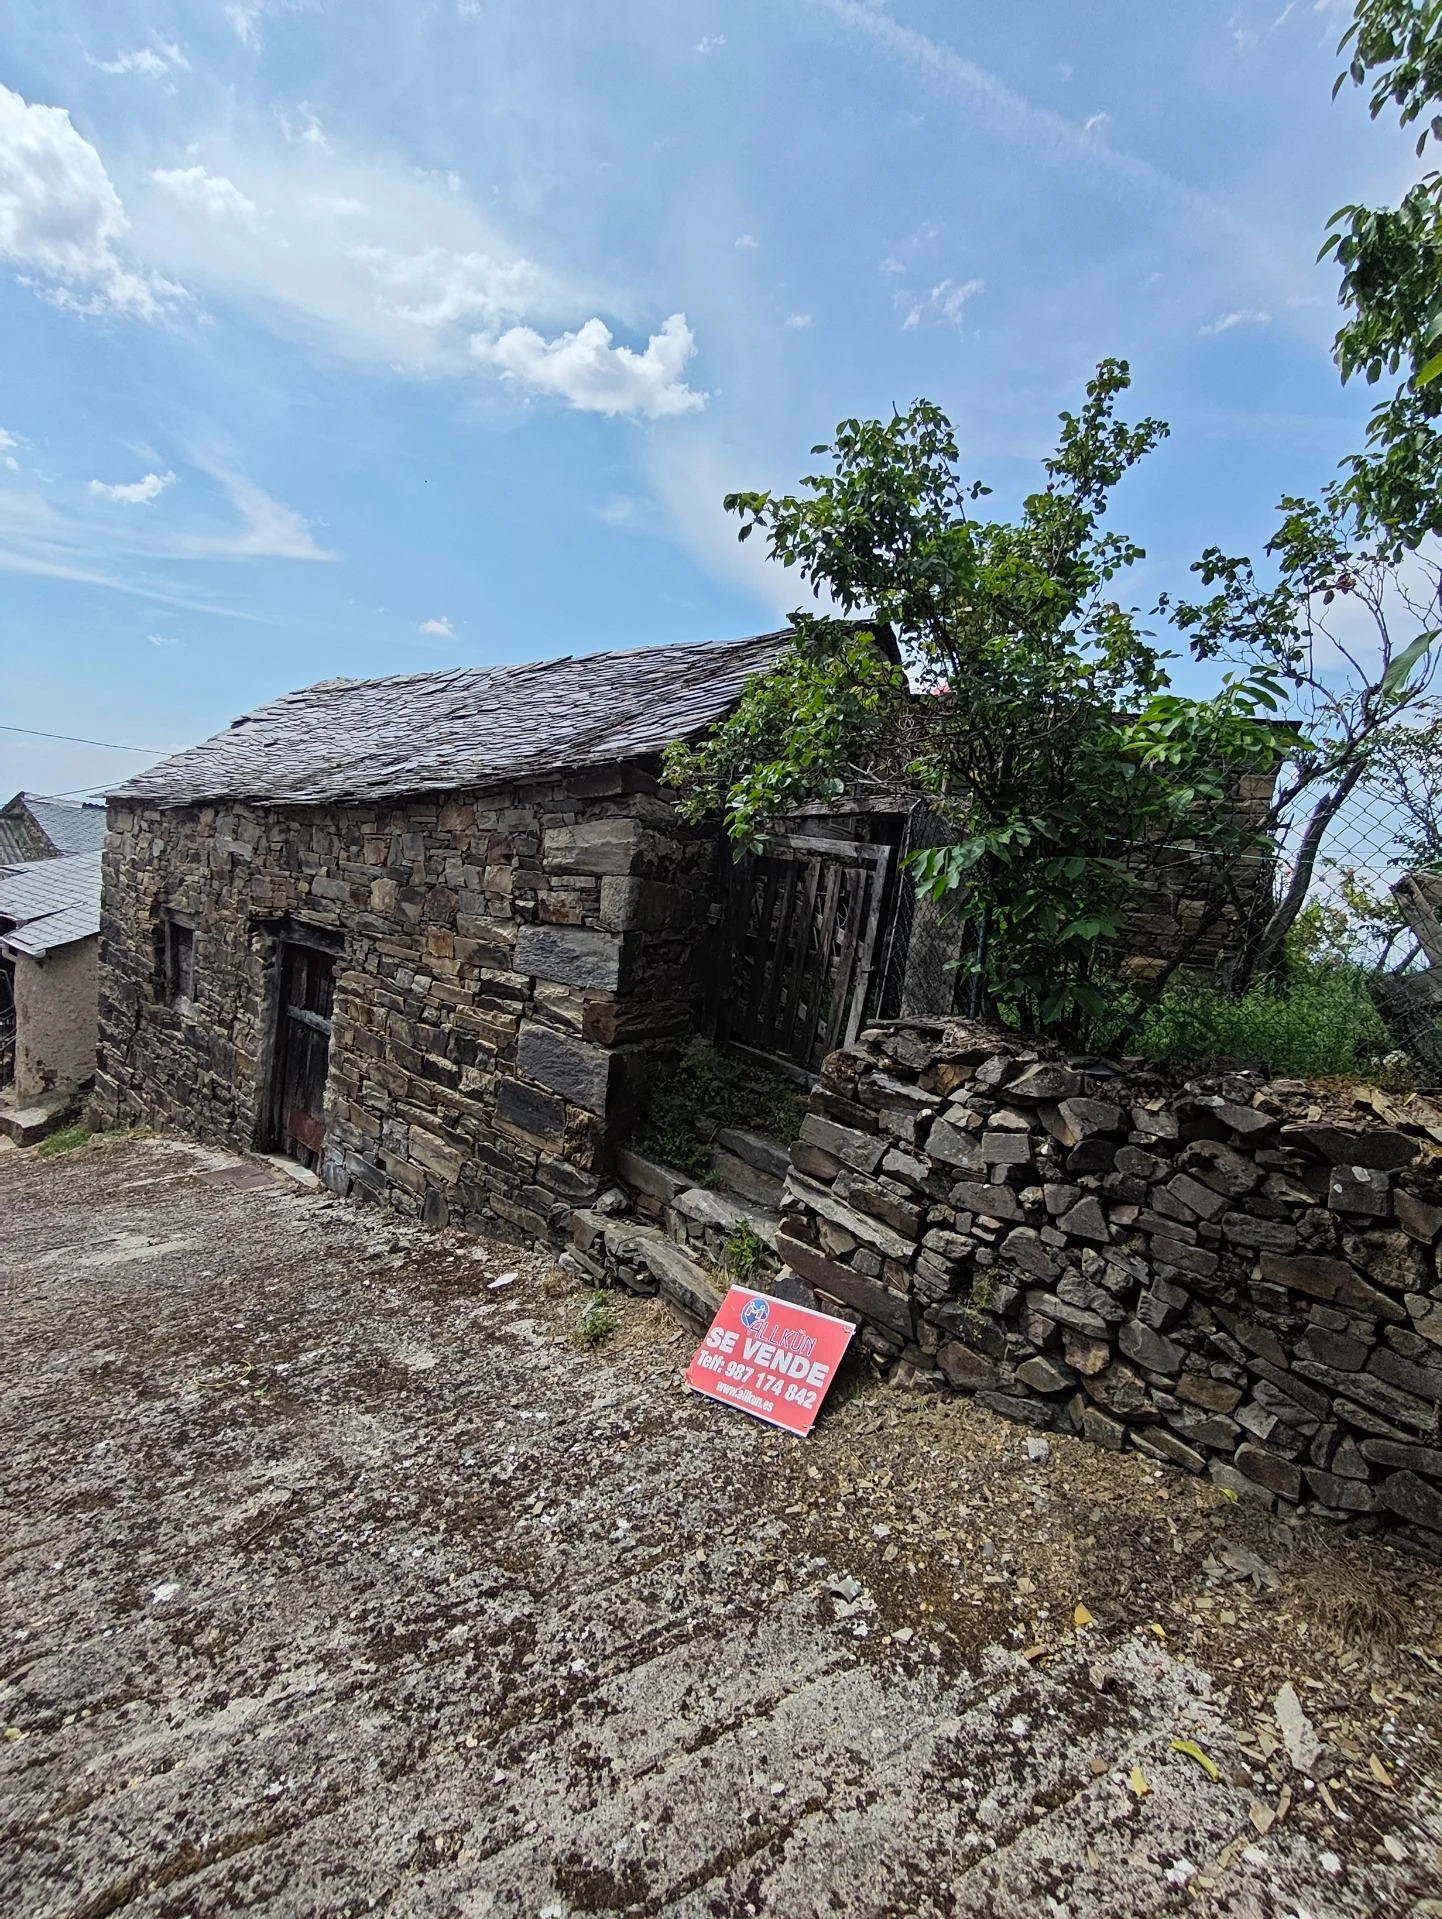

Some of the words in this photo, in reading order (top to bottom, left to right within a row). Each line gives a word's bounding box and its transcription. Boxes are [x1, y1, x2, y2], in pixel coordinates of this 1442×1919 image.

[697, 1350, 725, 1373] Telf:
[724, 1361, 755, 1383] 987
[755, 1372, 785, 1396] 174
[784, 1383, 817, 1409] 842
[706, 1327, 740, 1354] SE
[742, 1337, 830, 1388] VENDE
[716, 1381, 774, 1412] www.allkun.es
